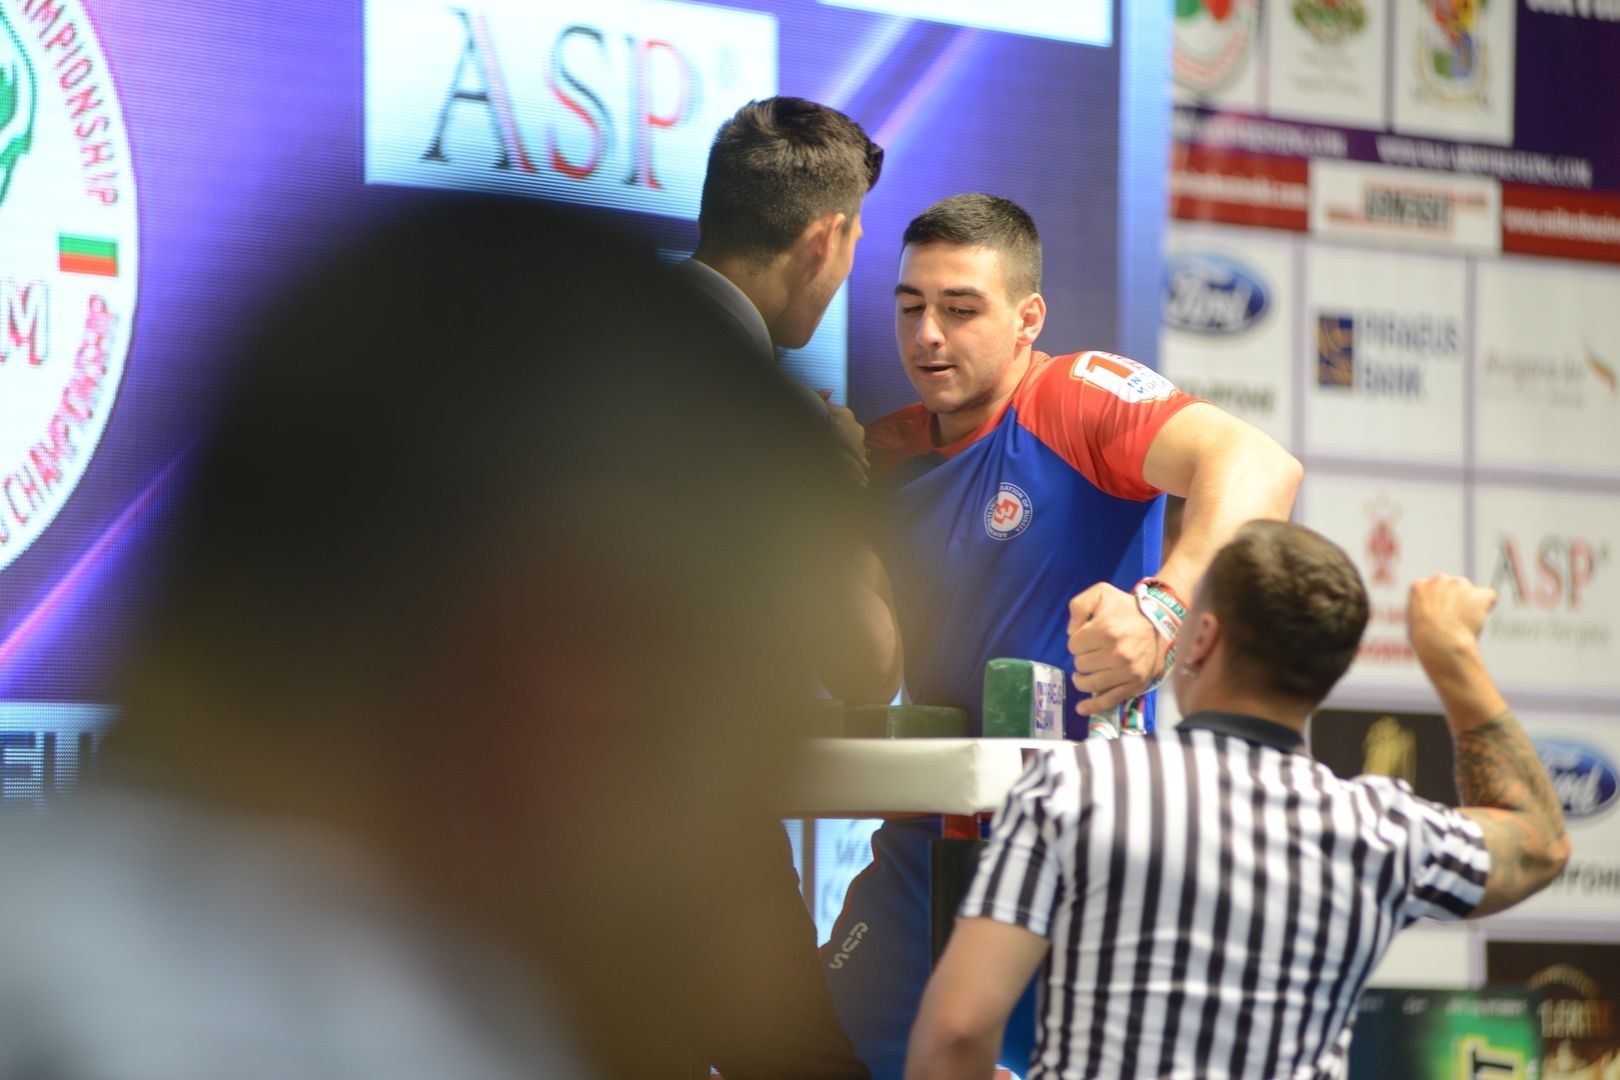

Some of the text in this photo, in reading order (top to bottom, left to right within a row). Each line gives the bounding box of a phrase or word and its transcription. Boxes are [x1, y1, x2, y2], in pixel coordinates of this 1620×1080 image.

[420, 5, 700, 191] ASP
[1489, 532, 1596, 612] ASP
[829, 922, 869, 969] RUS
